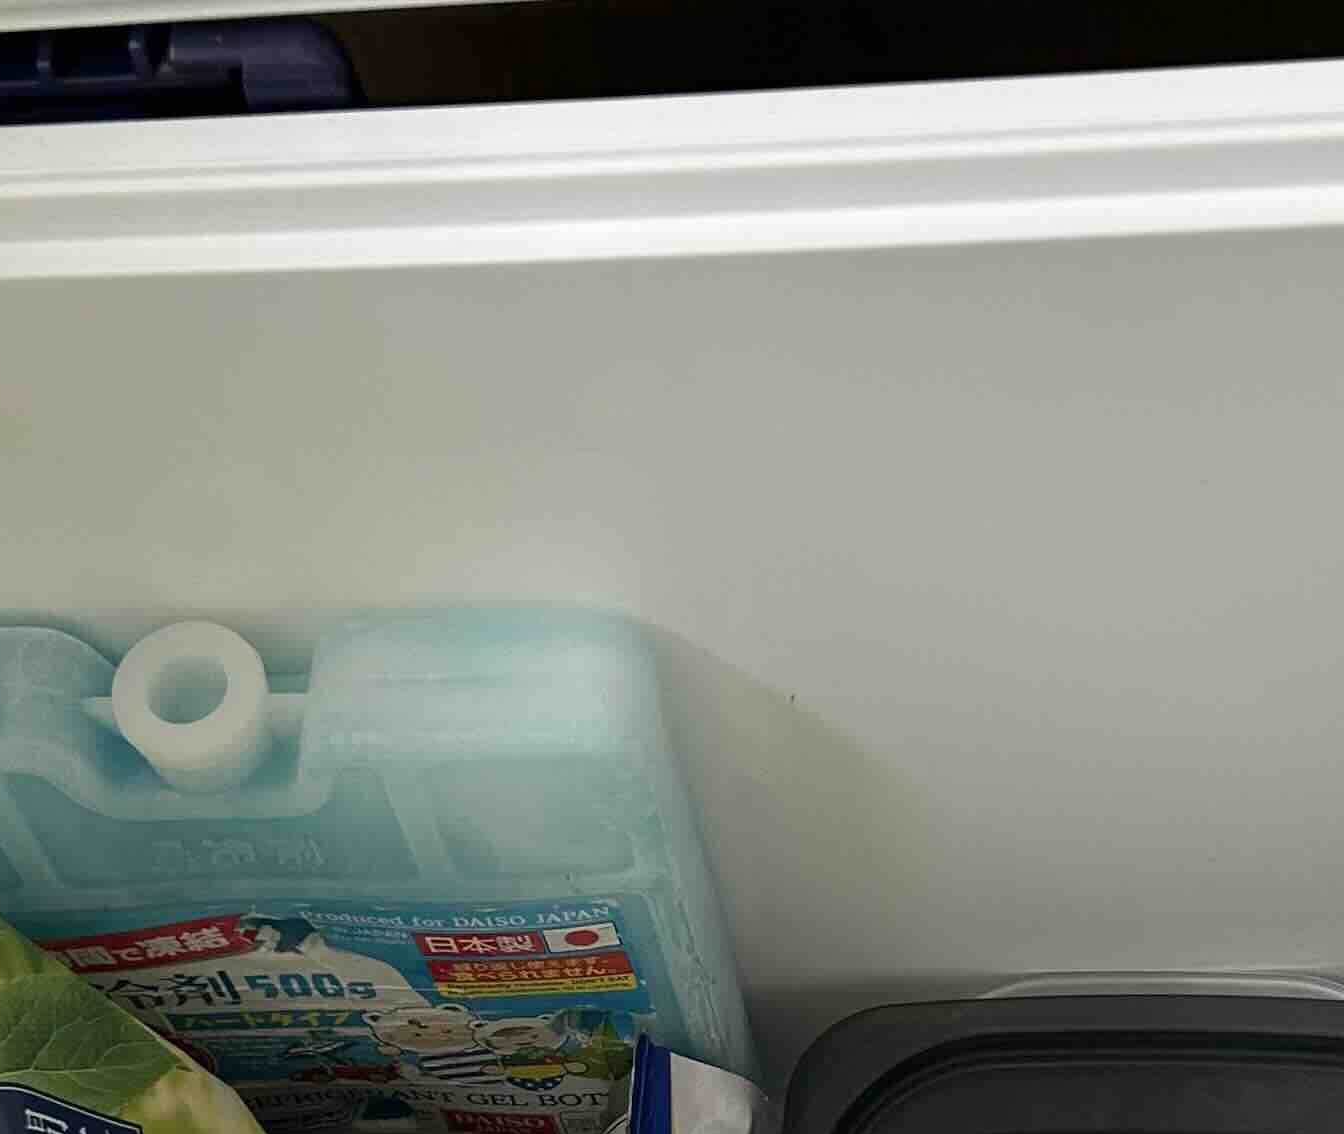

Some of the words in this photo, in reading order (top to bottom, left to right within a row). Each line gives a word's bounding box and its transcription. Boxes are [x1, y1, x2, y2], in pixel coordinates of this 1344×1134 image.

[411, 914, 446, 929] for
[453, 912, 527, 929] DAISO
[535, 905, 611, 926] JAPAN
[424, 933, 542, 955] 日本製
[465, 1092, 531, 1107] GEL
